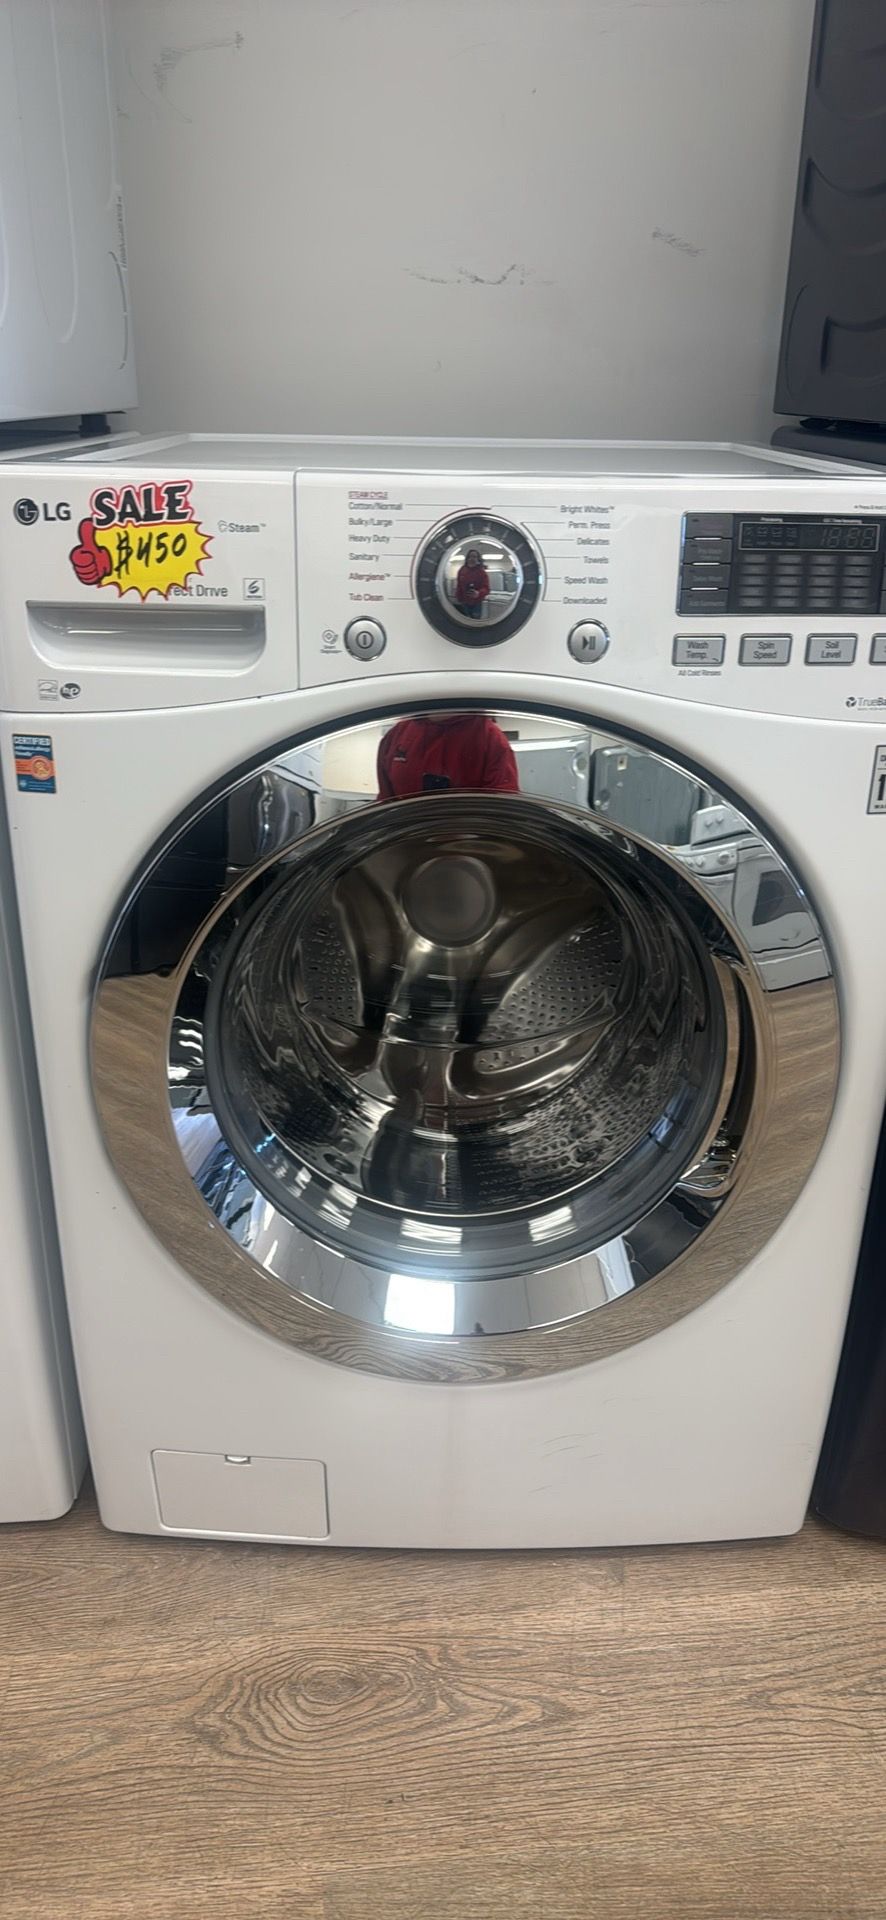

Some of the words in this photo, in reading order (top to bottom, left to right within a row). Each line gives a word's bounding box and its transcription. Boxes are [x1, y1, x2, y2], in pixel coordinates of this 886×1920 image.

[93, 484, 190, 527] SALE
[348, 501, 403, 510] Cotton/Normal
[560, 504, 583, 514] Bright
[43, 502, 72, 521] LG
[348, 518, 393, 527] Bulky/Large
[591, 521, 611, 529] Press
[348, 535, 372, 543] Heavy
[373, 535, 390, 544] Duty
[576, 537, 610, 545] Delicates
[114, 530, 187, 579] $450
[349, 552, 380, 562] Sanitary
[584, 556, 609, 564] Towels
[564, 576, 587, 585] Speed
[196, 584, 228, 597] Drive
[349, 592, 362, 601] Tub
[363, 593, 384, 601] Clean
[687, 641, 709, 649] Wash
[757, 641, 776, 650] Spin
[825, 640, 839, 649] Soil
[753, 650, 778, 660] Speed
[821, 650, 841, 659] Level
